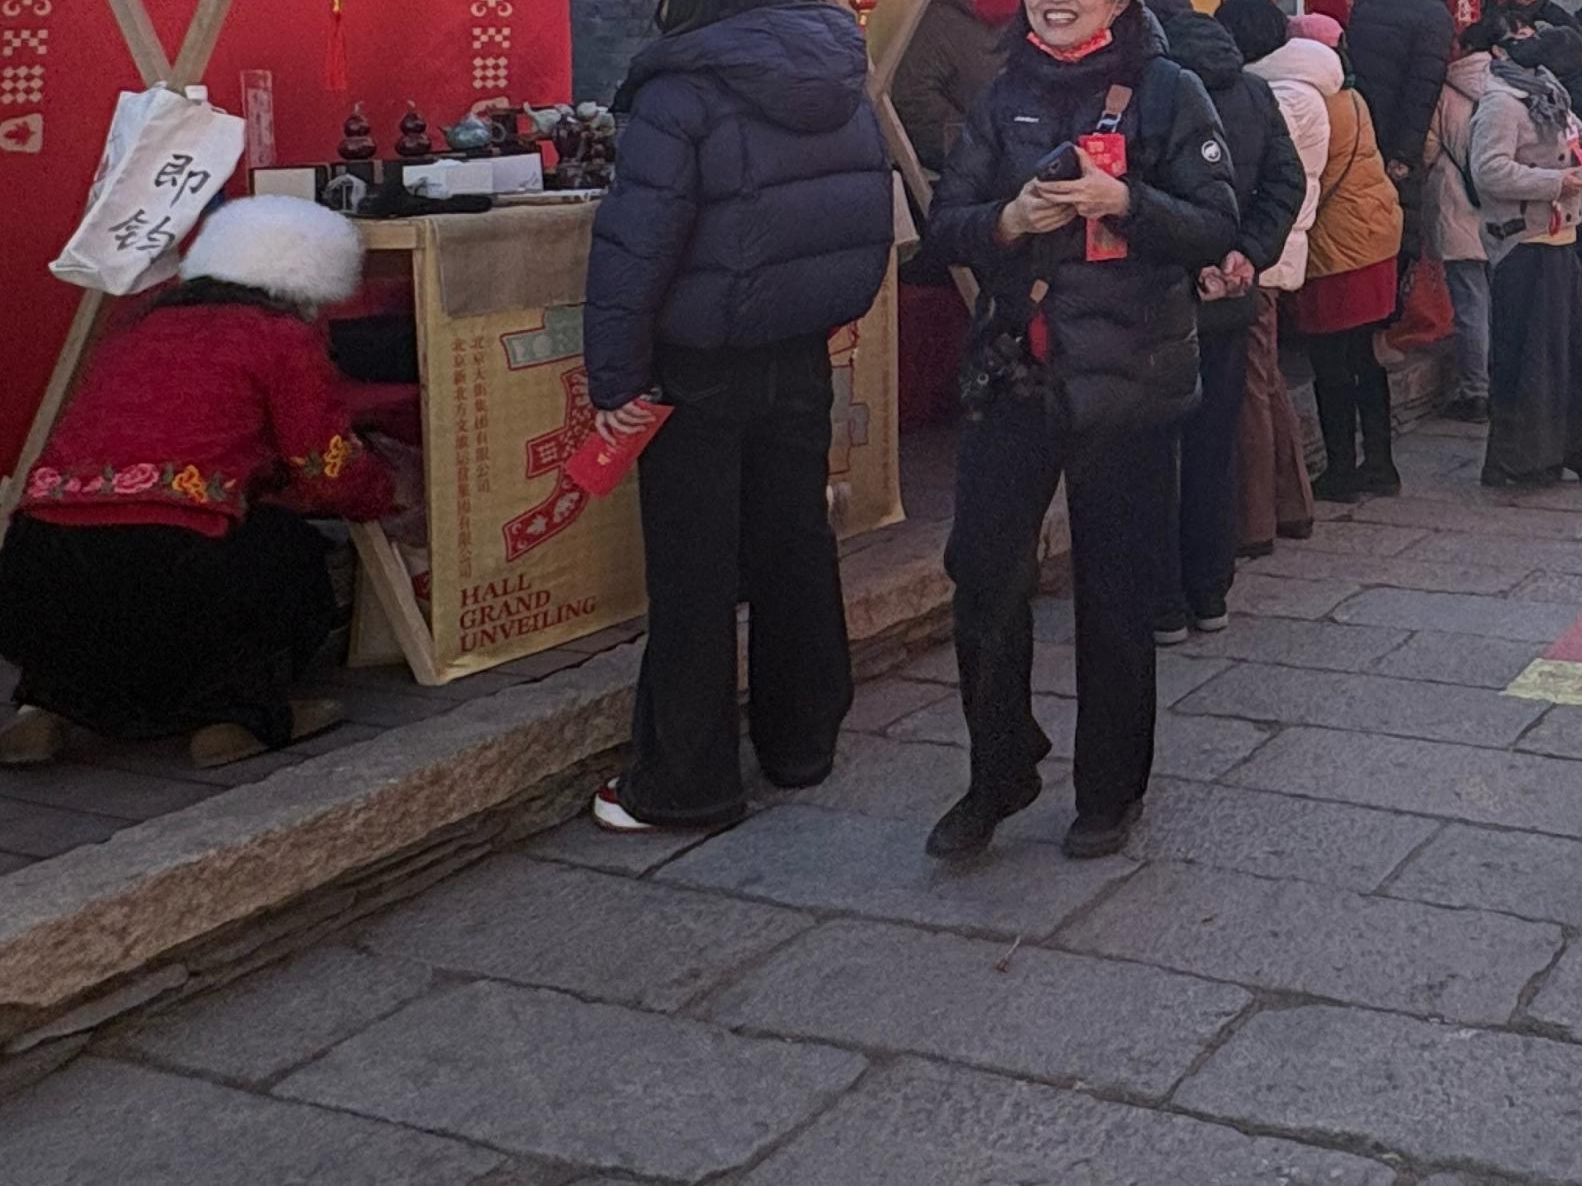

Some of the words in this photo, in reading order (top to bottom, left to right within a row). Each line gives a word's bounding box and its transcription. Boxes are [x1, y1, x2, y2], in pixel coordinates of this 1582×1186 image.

[459, 573, 532, 609] HALL
[459, 590, 551, 631] GRAND
[460, 596, 597, 653] UNVEILING
